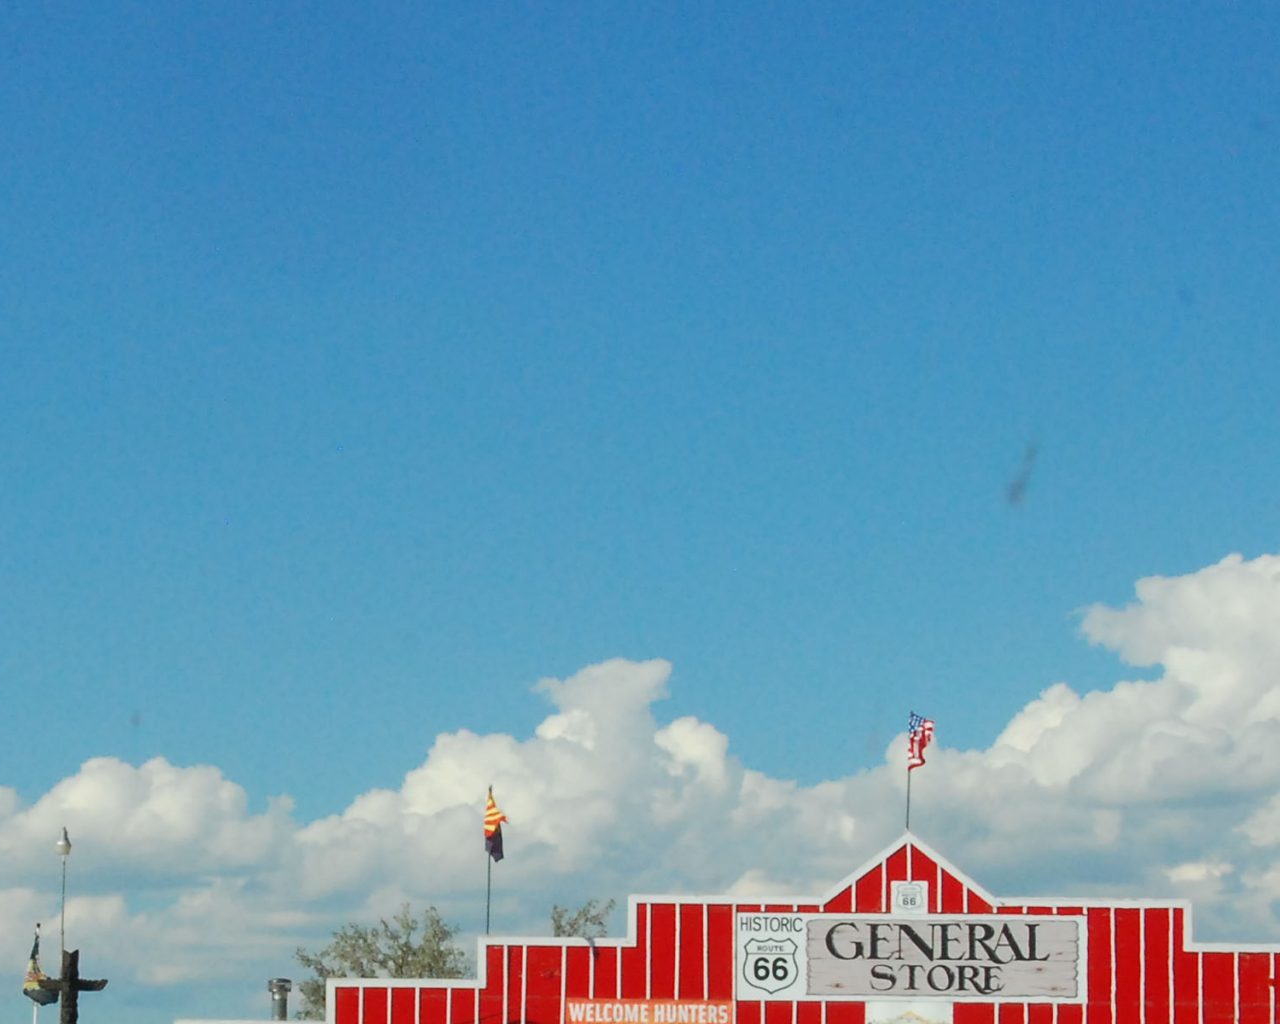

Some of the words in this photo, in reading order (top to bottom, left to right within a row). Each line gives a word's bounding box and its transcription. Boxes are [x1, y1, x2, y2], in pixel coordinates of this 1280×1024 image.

[902, 896, 917, 906] 66
[740, 916, 803, 932] HISTORIC
[825, 922, 1050, 964] GENERAL
[753, 957, 788, 981] 66
[870, 964, 1005, 994] STORE
[568, 1002, 649, 1023] WELCOME
[654, 1004, 729, 1024] HUNTERS
